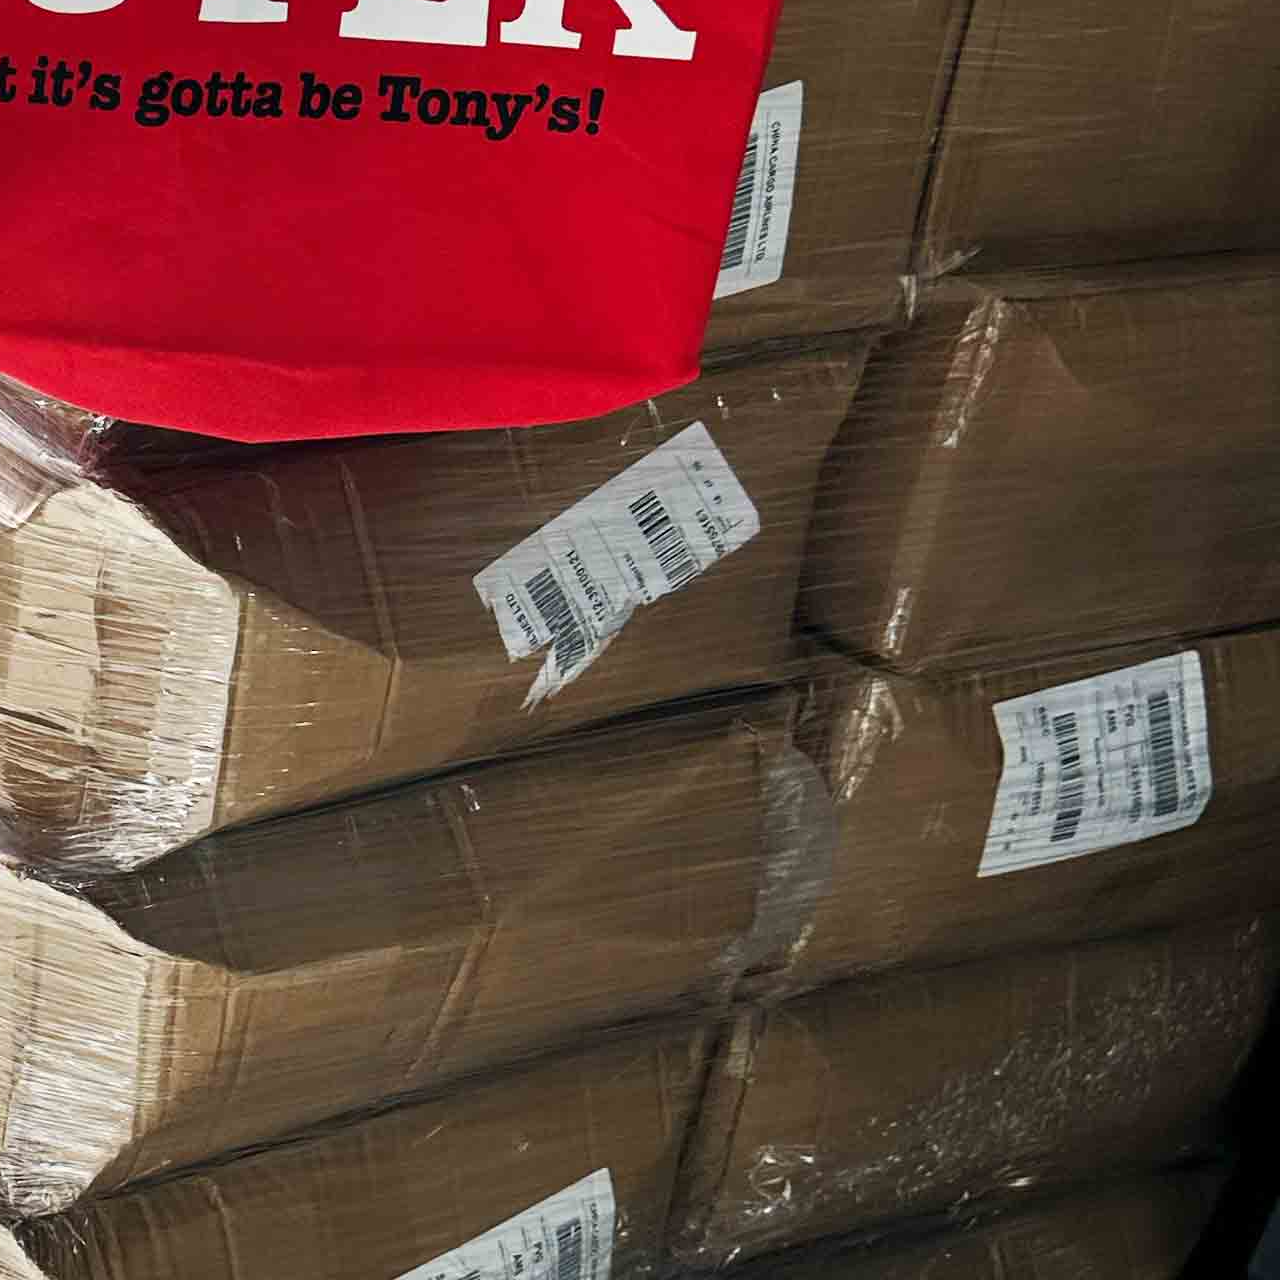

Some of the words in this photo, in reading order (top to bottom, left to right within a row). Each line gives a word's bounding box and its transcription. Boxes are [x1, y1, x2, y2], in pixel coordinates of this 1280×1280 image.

[27, 55, 122, 112] it's
[134, 70, 283, 128] gotta
[297, 72, 363, 119] be
[378, 74, 606, 141] Tony's!
